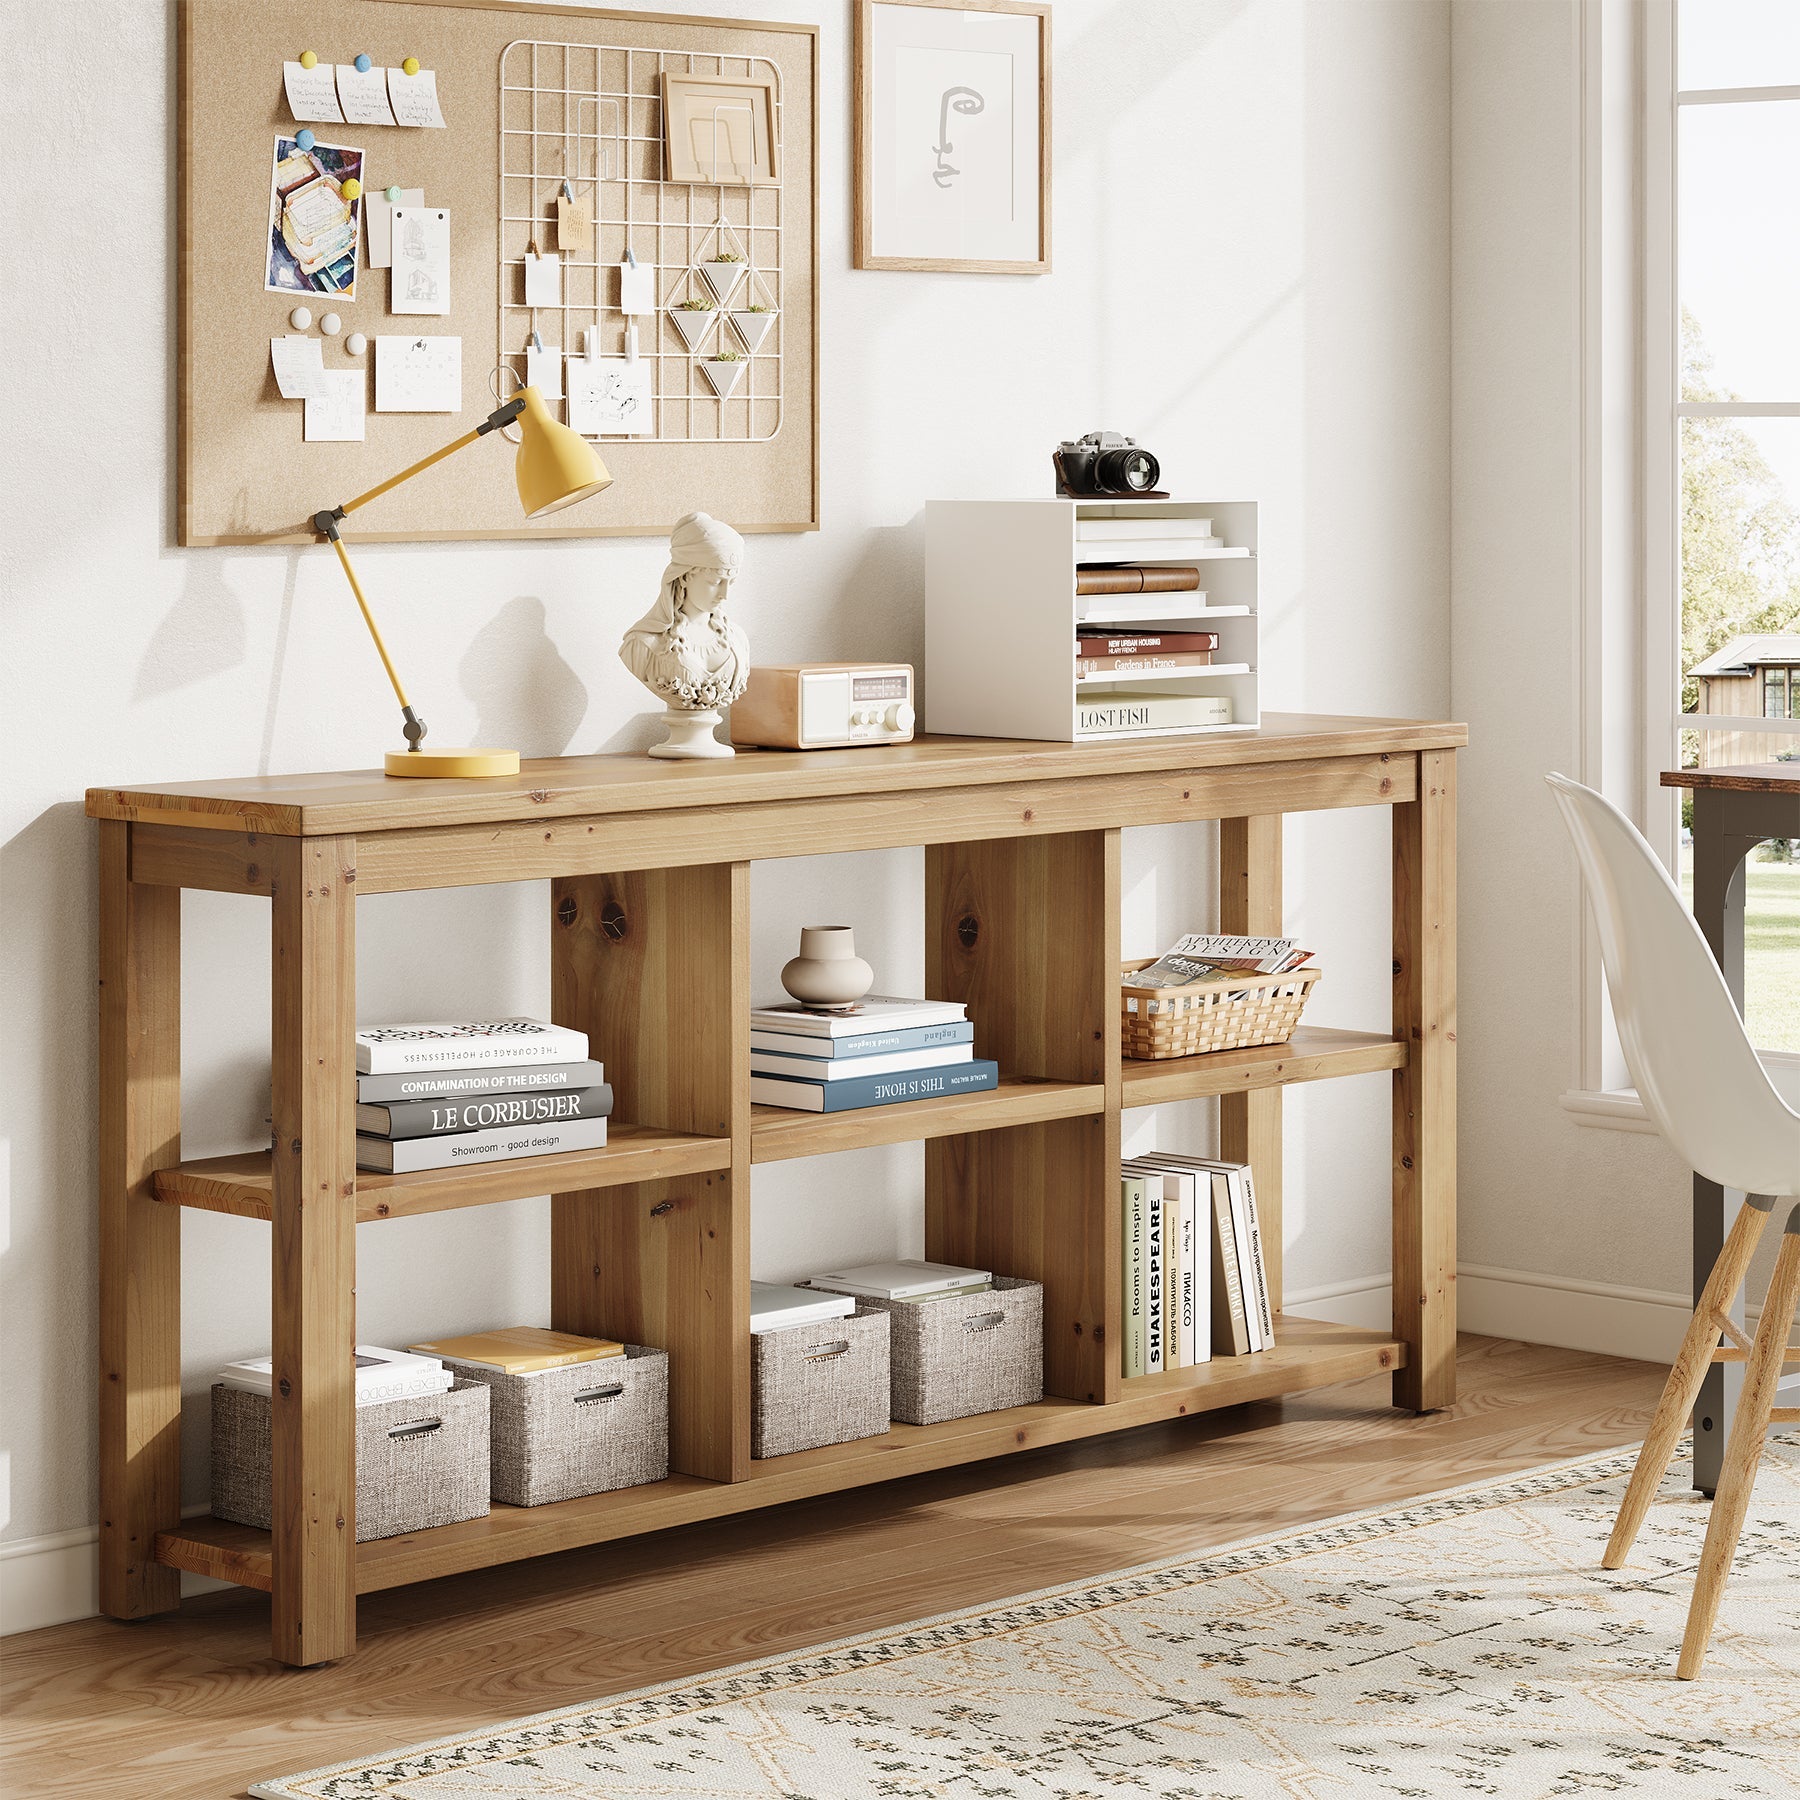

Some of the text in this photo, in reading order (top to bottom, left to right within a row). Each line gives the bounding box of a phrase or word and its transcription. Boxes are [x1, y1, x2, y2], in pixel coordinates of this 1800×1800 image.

[1108, 638, 1161, 648] NEW URBAN HOUSING
[1108, 647, 1121, 655] HILARY
[1114, 658, 1176, 670] Gardens in France
[1081, 708, 1149, 728] LOST FISH
[1182, 945, 1283, 956] DESIGN
[847, 1030, 957, 1049] England United Kingdom
[404, 1046, 558, 1063] THE COURAGE OF HOPELESSNESS
[401, 1072, 567, 1093] CONTAMINATION OF THE DESIGN
[875, 1077, 945, 1099] THIS IS HOME
[951, 1073, 988, 1085] NATALIE WALTON
[431, 1094, 581, 1130] LE CORBUSIER
[451, 1143, 498, 1157] Showroom
[507, 1139, 529, 1152] good
[531, 1135, 560, 1149] design
[1132, 1192, 1141, 1316] Rooms to Inspire
[1220, 1216, 1243, 1321] СПАСИТЕ КОТИКА!
[1150, 1199, 1160, 1363] SHAKESPEARE
[1251, 1230, 1270, 1337] Метод управления проектами
[1183, 1271, 1192, 1327] ПИКАССО
[406, 1375, 450, 1393] ALEXEY
